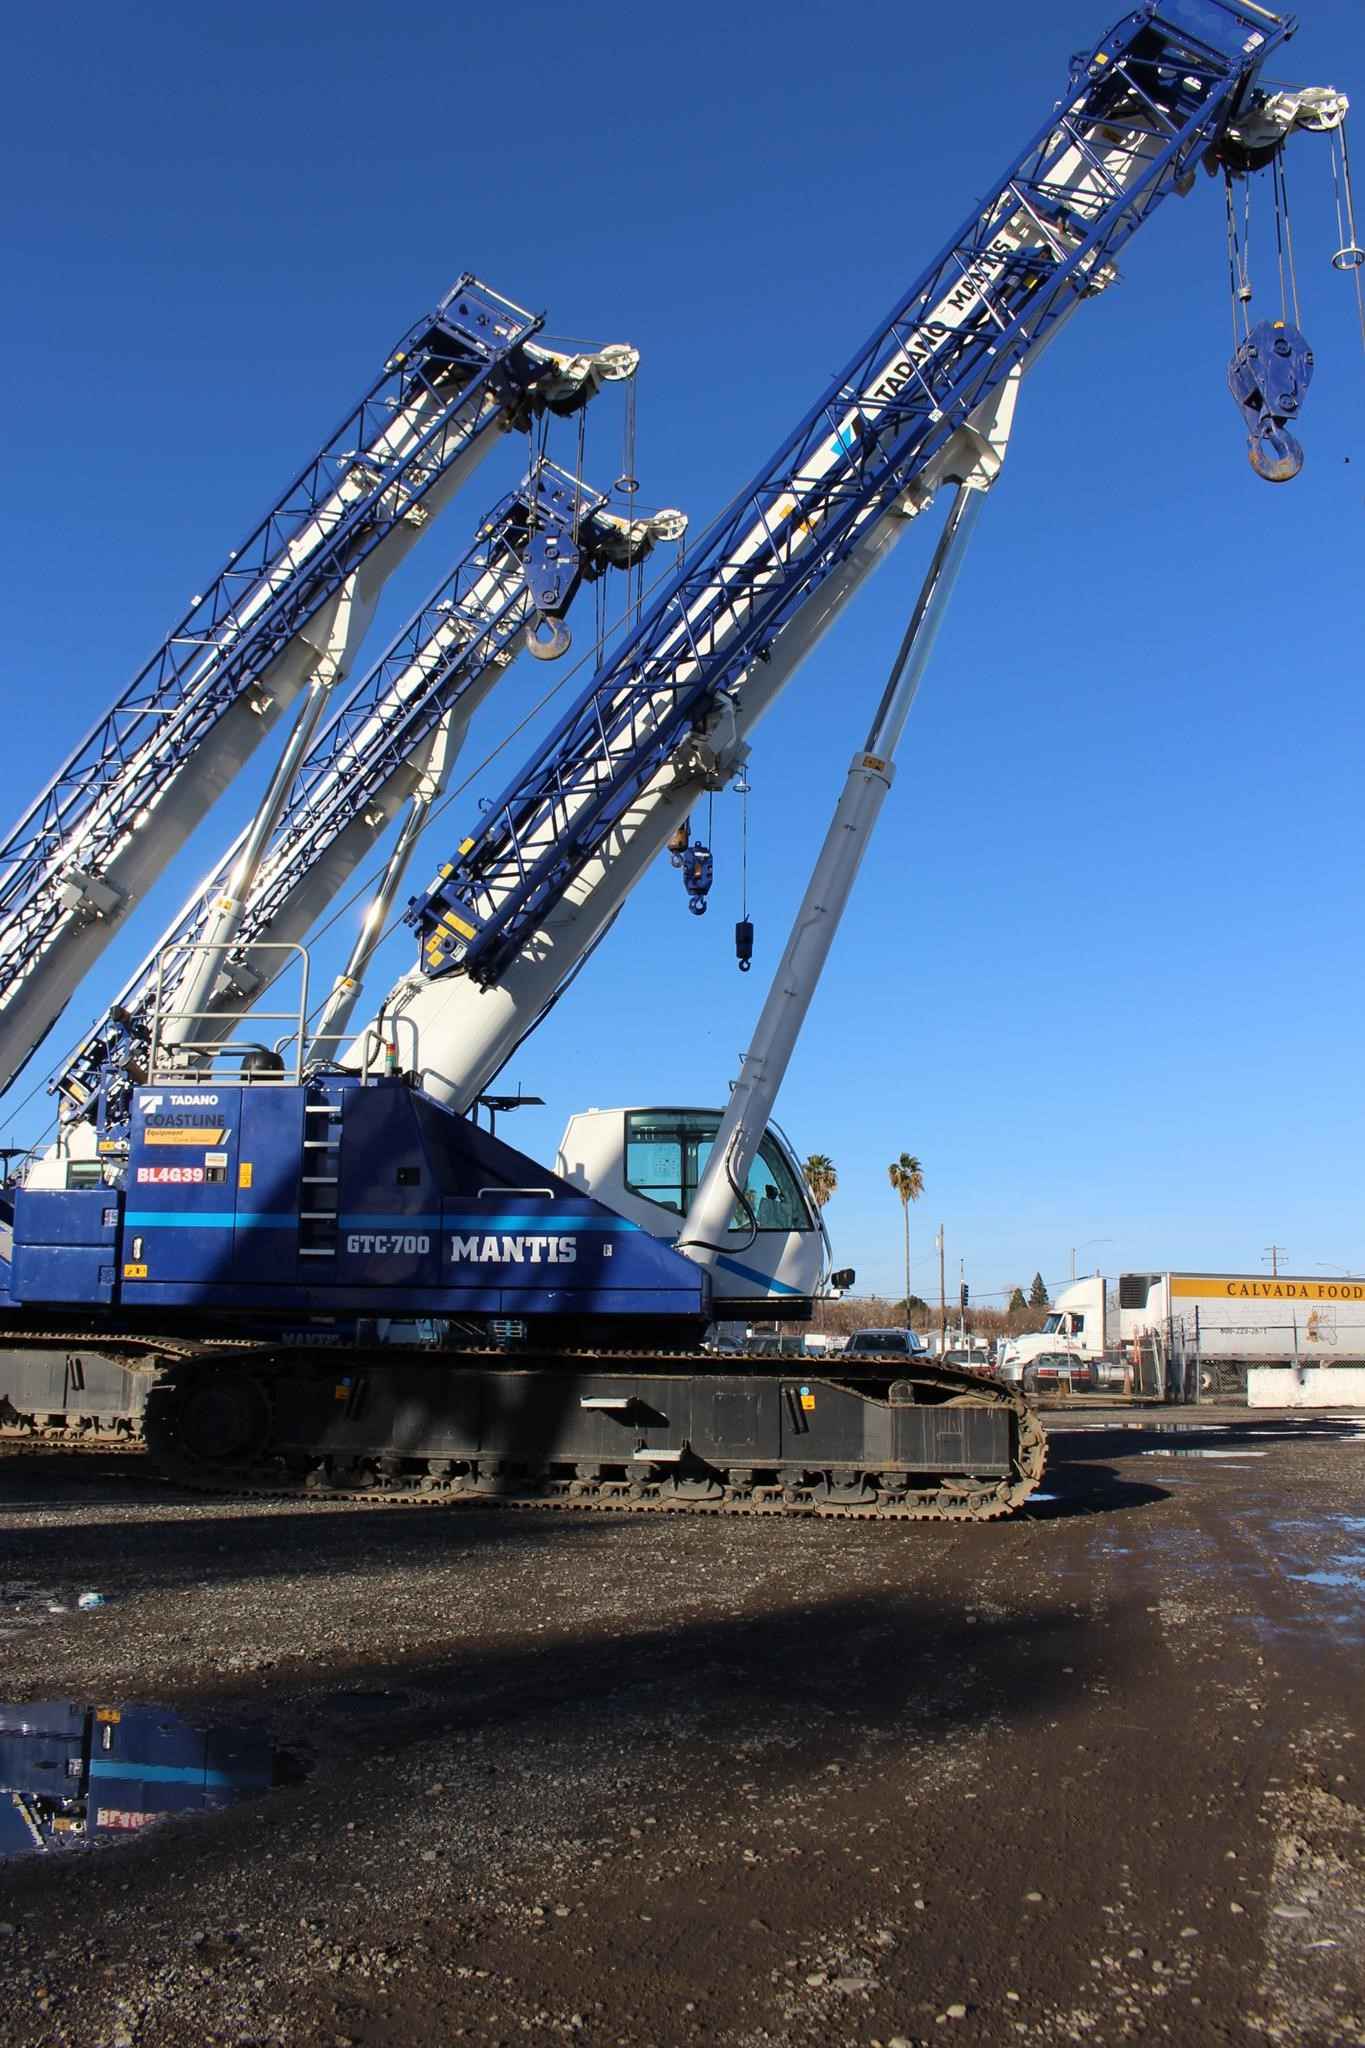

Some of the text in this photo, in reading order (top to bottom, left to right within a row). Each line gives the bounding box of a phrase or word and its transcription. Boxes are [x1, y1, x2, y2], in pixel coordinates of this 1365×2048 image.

[874, 320, 946, 399] TADANO
[170, 1094, 219, 1105] TADANO
[144, 1113, 225, 1126] COASTLINE
[137, 1168, 204, 1183] BL4G39
[347, 1235, 577, 1263] GTC-700 MANTIS
[1227, 1283, 1363, 1299] CALVADA FOOD
